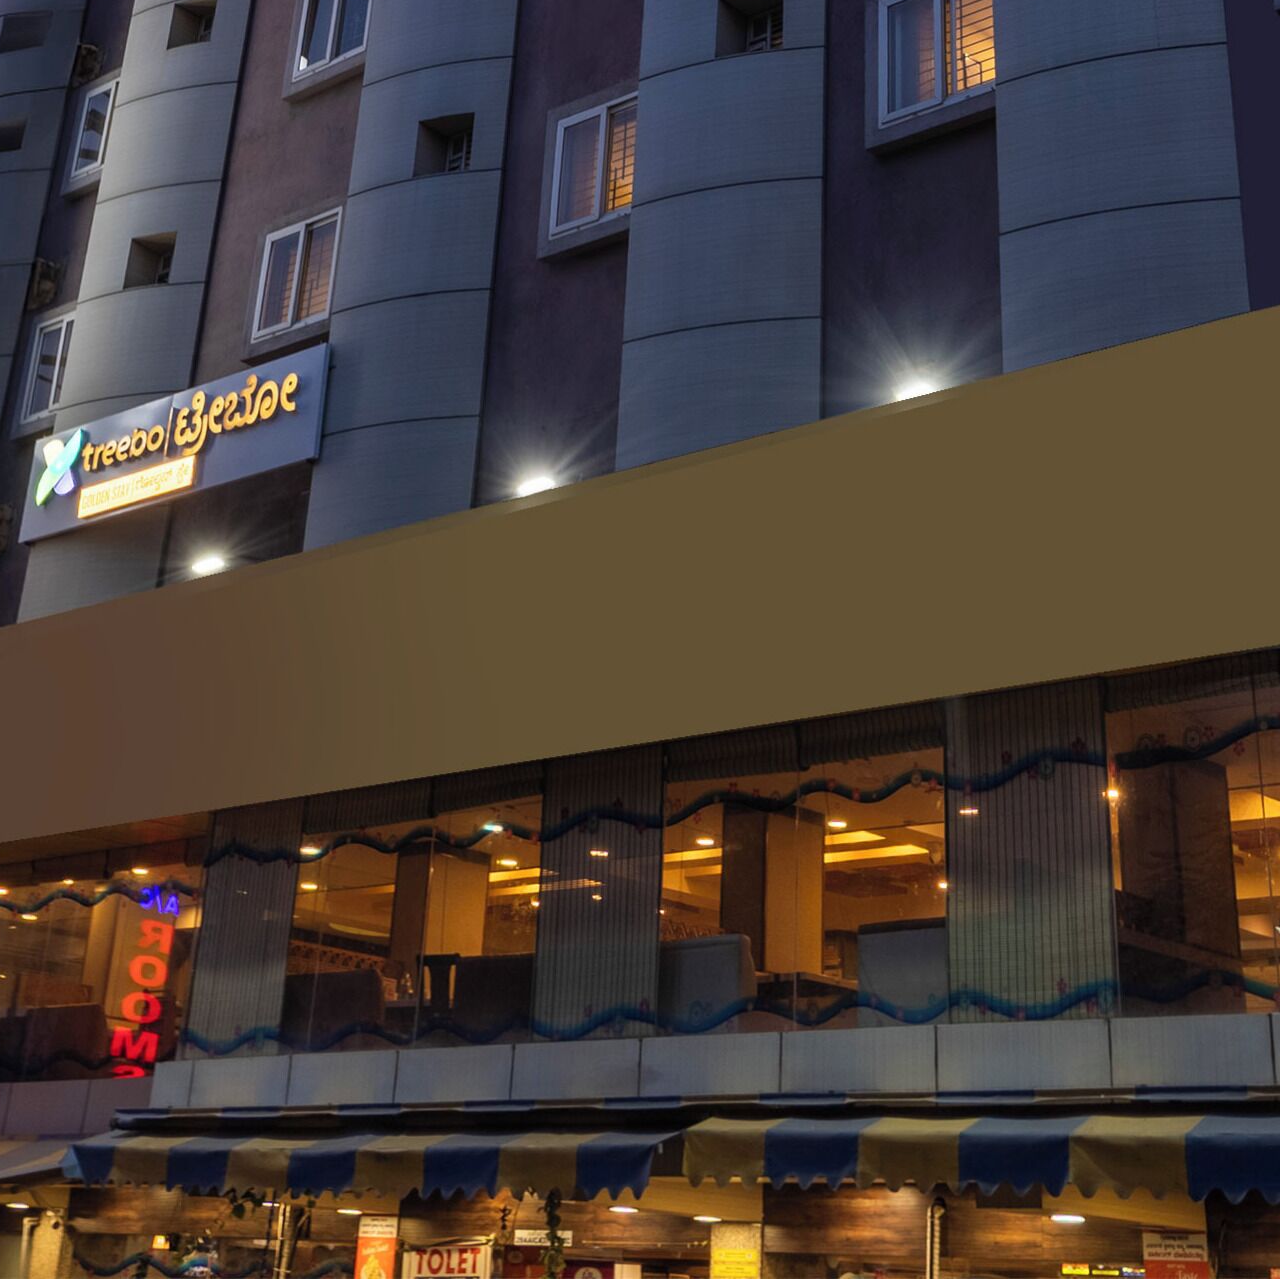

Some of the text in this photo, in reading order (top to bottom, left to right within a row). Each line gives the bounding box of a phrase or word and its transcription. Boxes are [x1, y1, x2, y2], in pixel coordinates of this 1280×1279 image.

[81, 424, 165, 472] treebo
[81, 488, 111, 511] GOLDEN
[415, 1247, 481, 1275] TOLET
